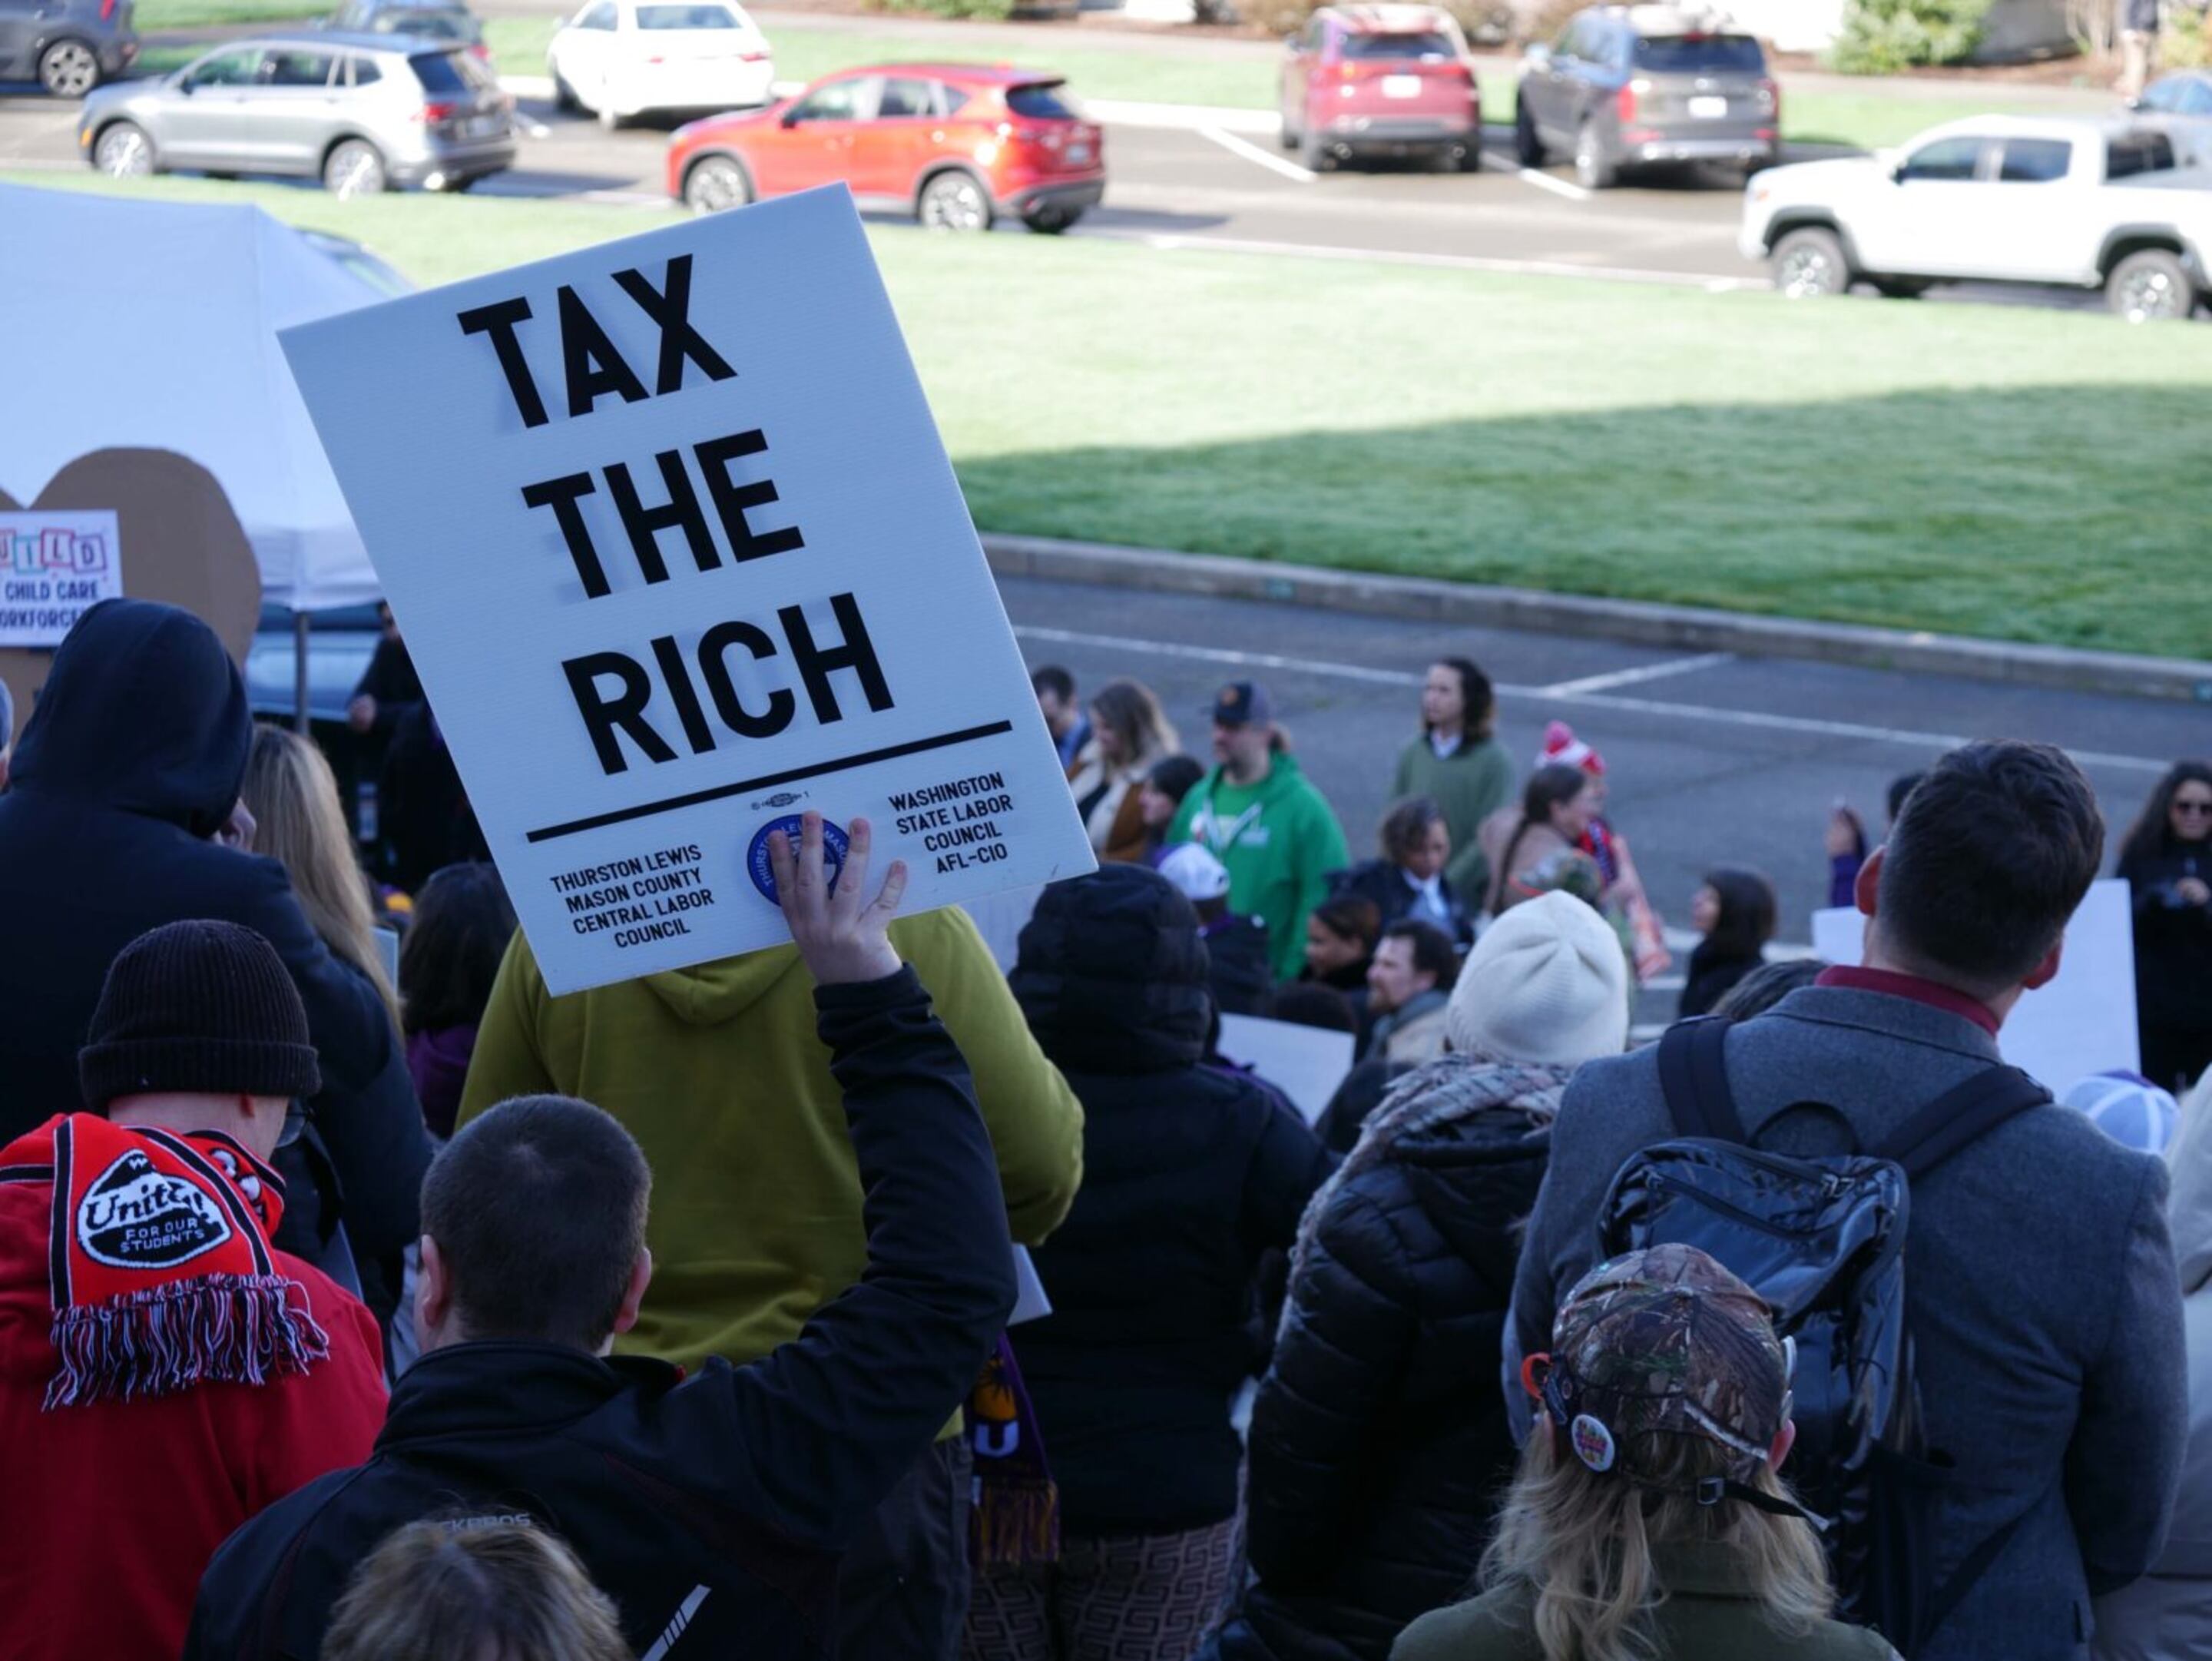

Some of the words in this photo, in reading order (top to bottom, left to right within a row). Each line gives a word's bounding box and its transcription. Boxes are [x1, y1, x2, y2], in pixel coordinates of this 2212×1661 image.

[456, 254, 739, 429] TAX
[520, 428, 806, 600] THE
[5, 582, 50, 601] CHILD
[561, 592, 895, 776] RICH
[888, 771, 1005, 812] WASHINGTON
[896, 807, 952, 835] STATE
[952, 794, 1014, 823] LABOR
[924, 821, 1003, 852] COUNCIL
[549, 857, 643, 893] THURSTON
[644, 844, 702, 872] LEWIS
[937, 843, 1008, 874] AFL-CIO
[565, 884, 631, 914] MASON
[632, 867, 702, 897] COUNTY
[572, 903, 654, 935] CENTRAL
[654, 888, 715, 917] LABOR
[614, 917, 692, 949] COUNCIL
[120, 1229, 206, 1253] STUDENTS
[125, 1225, 160, 1240] FOR
[164, 1217, 198, 1234] OUR
